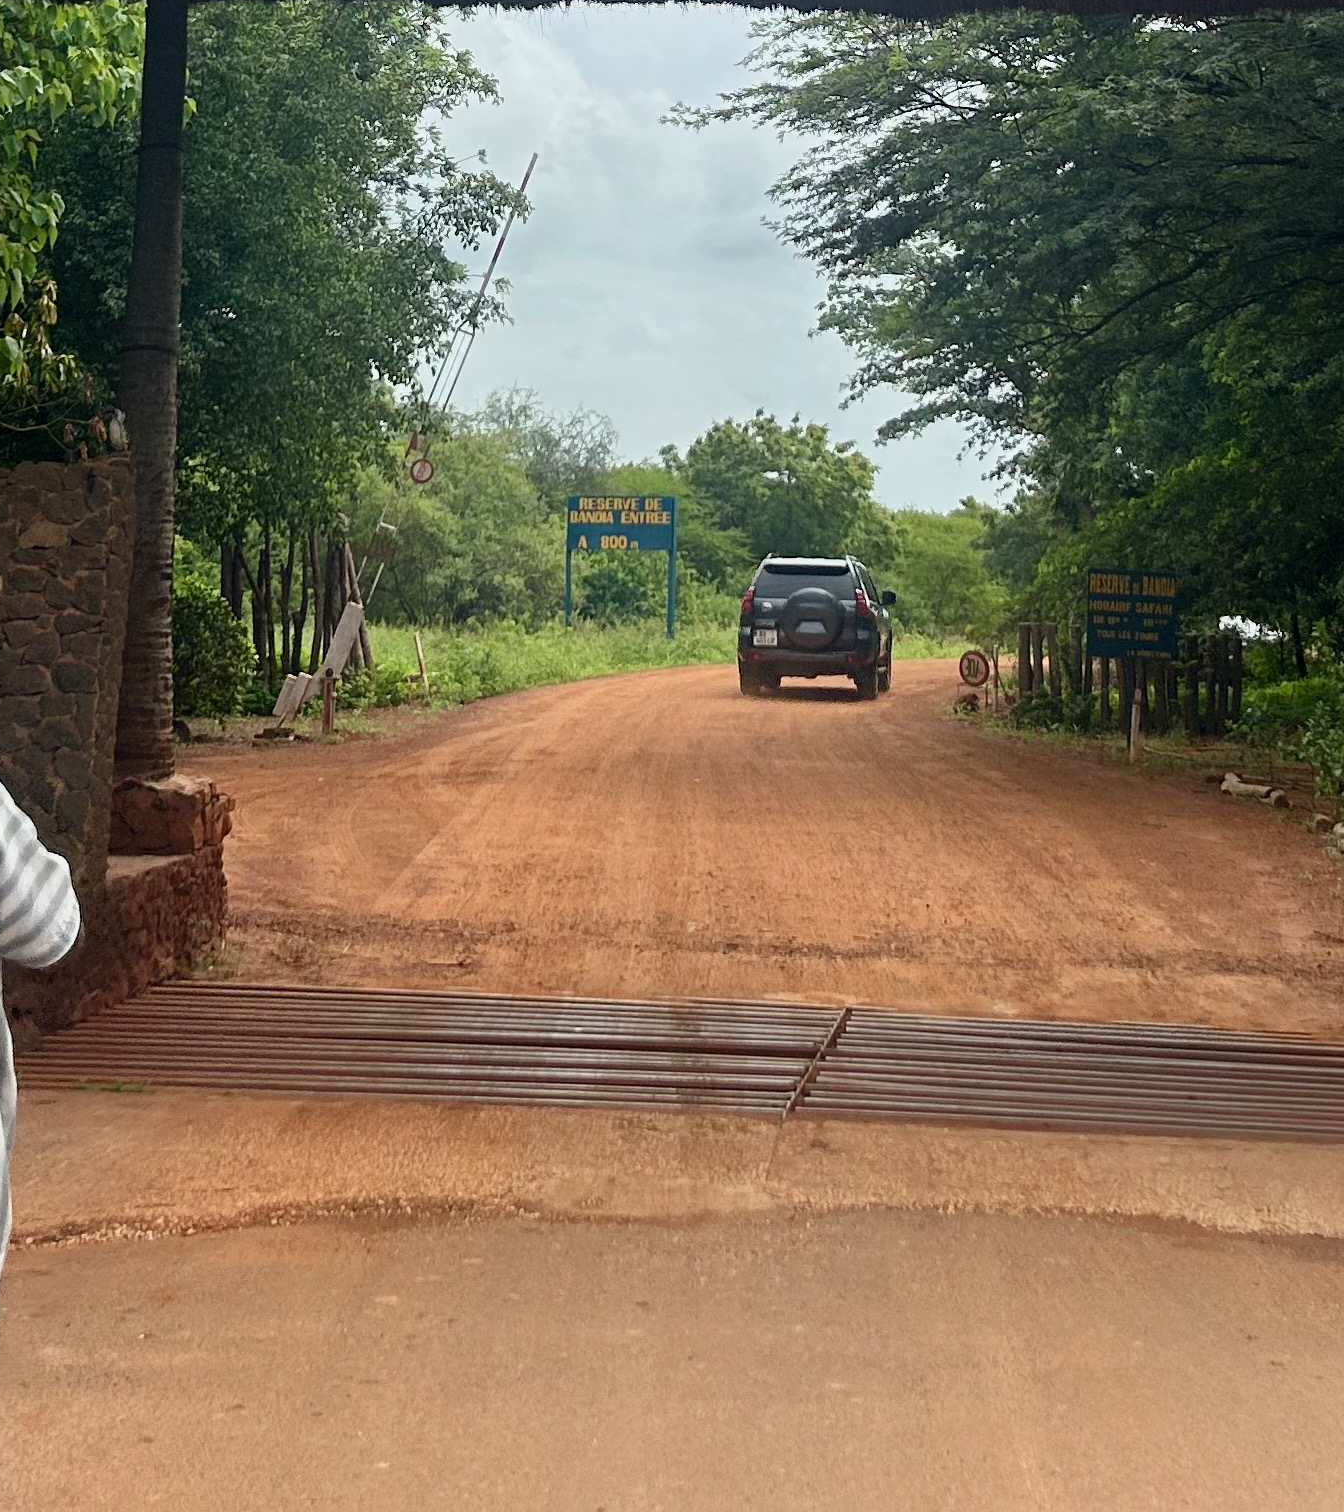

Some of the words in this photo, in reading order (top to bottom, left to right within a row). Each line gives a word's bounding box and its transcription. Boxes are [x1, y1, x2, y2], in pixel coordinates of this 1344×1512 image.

[579, 497, 640, 510] RESERVE
[645, 497, 662, 510] DE
[621, 511, 671, 524] ENTREE
[578, 535, 587, 549] A
[601, 536, 627, 549] 800
[1090, 573, 1131, 594] RESERVE
[1143, 576, 1176, 597] BANDIA
[1136, 602, 1172, 615] SAFARI
